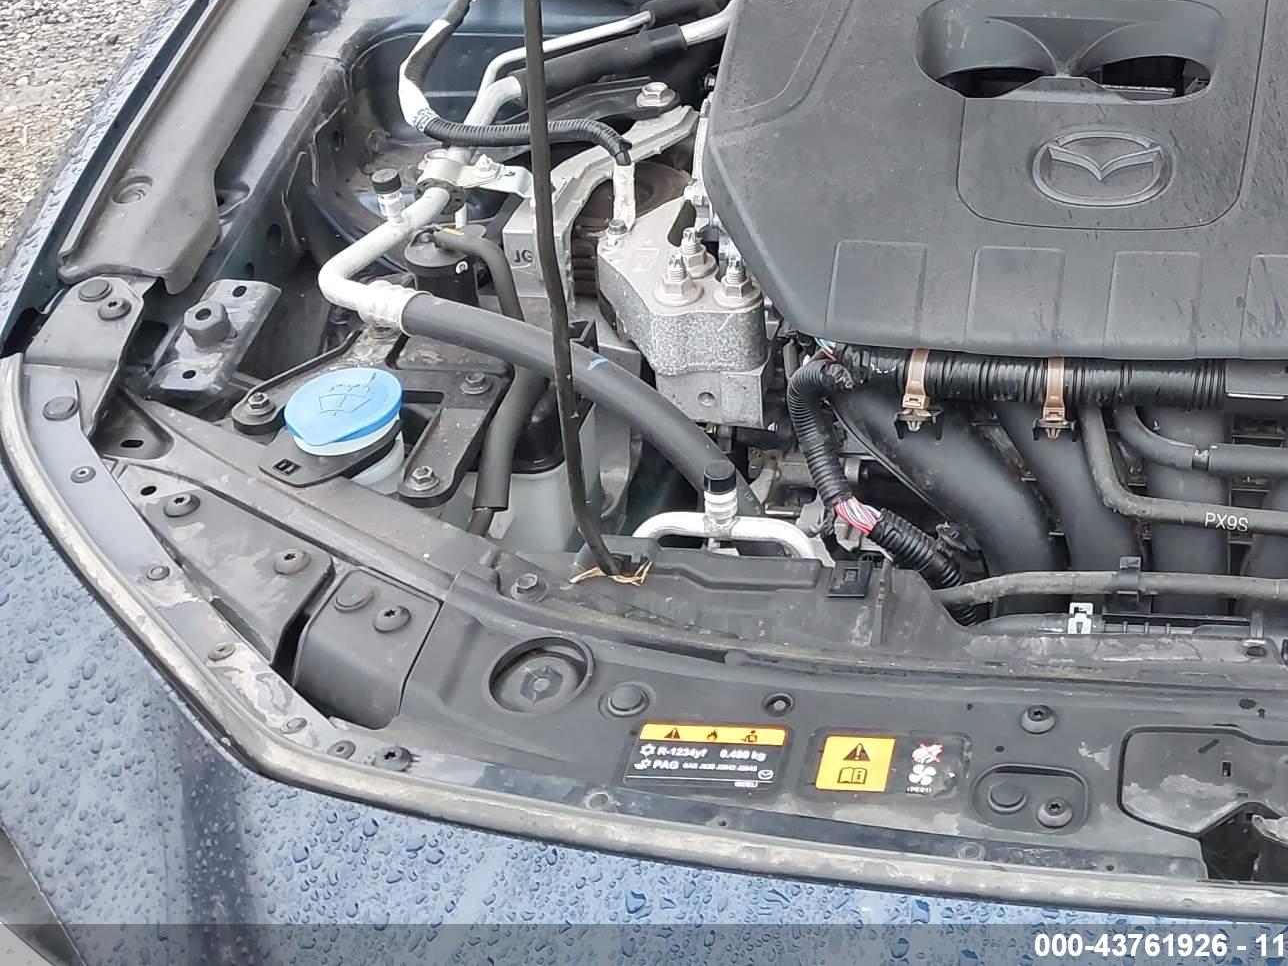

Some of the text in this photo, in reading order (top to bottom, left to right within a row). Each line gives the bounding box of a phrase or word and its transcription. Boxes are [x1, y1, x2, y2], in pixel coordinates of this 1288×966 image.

[1204, 511, 1249, 532] PX9S
[656, 746, 709, 759] R-1234yf
[751, 750, 768, 762] kg
[652, 759, 679, 770] PAG
